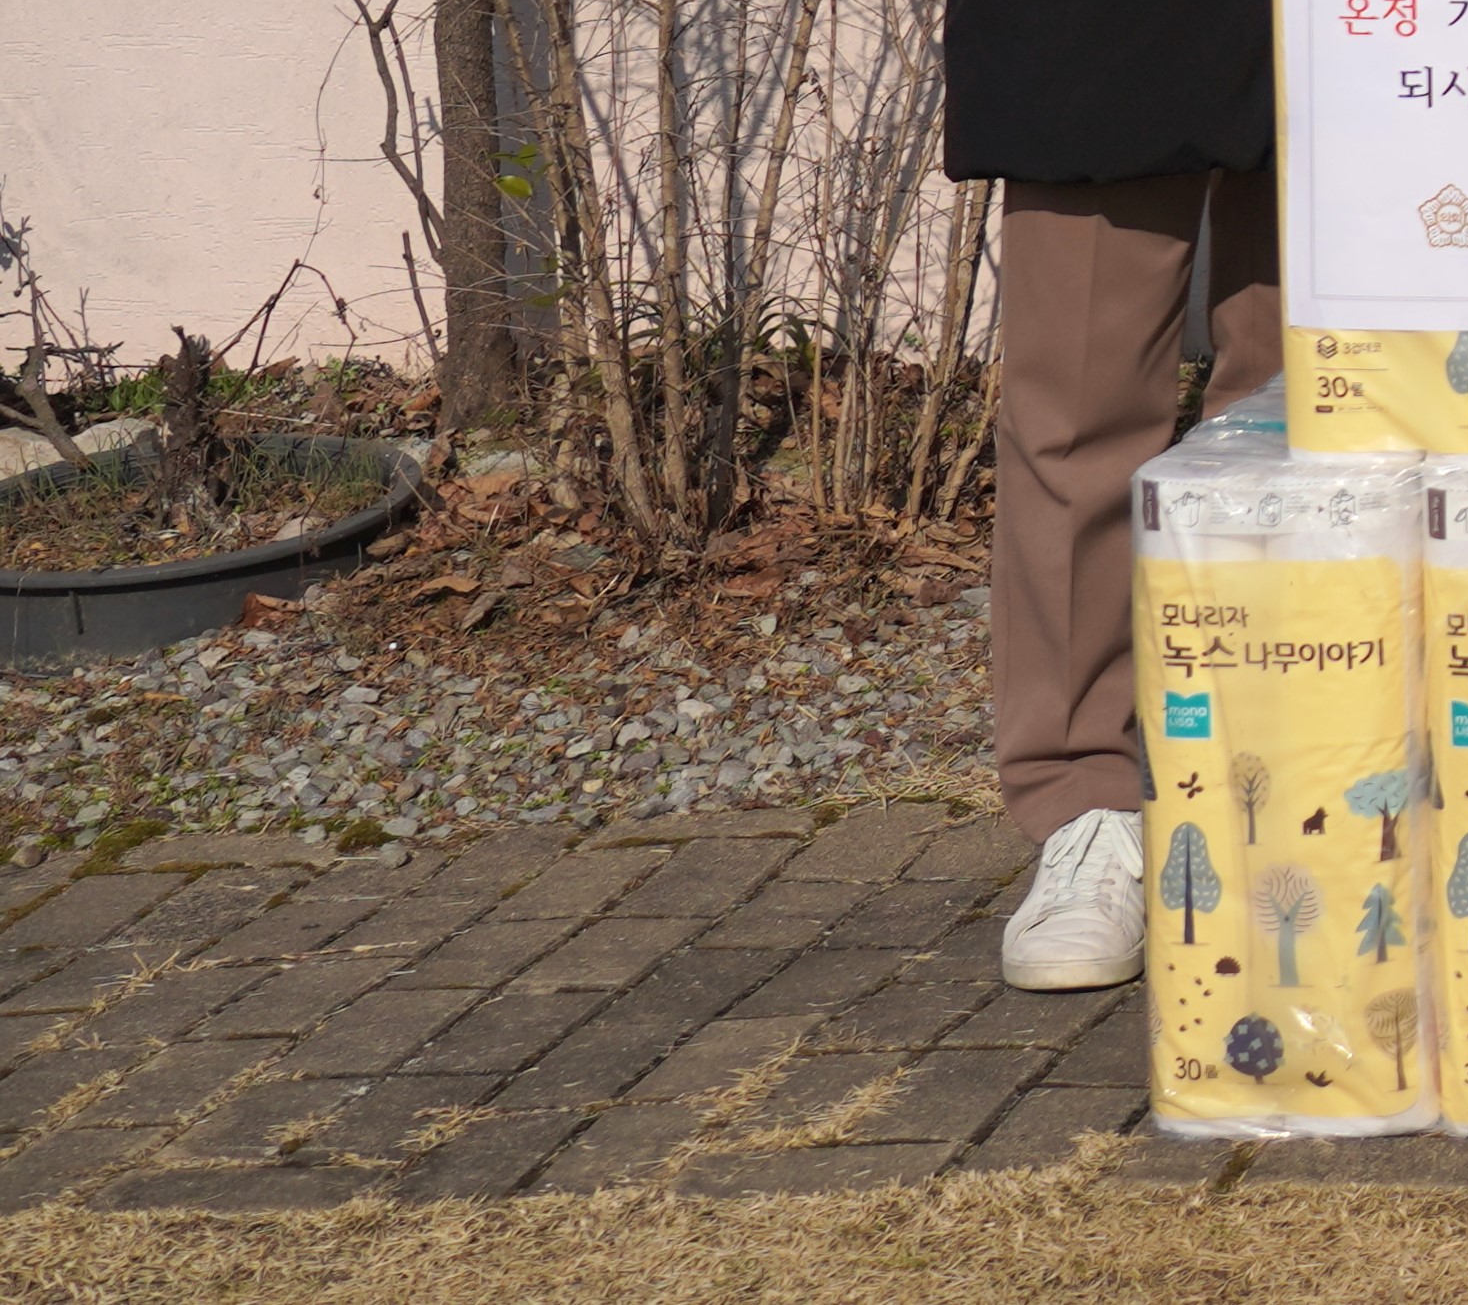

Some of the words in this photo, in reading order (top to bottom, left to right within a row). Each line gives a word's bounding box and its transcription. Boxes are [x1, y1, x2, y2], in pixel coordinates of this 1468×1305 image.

[1438, 210, 1463, 226] 의회
[1161, 601, 1248, 630] 모나리자
[1161, 634, 1238, 679] 녹스
[1244, 638, 1385, 674] 나무이야기
